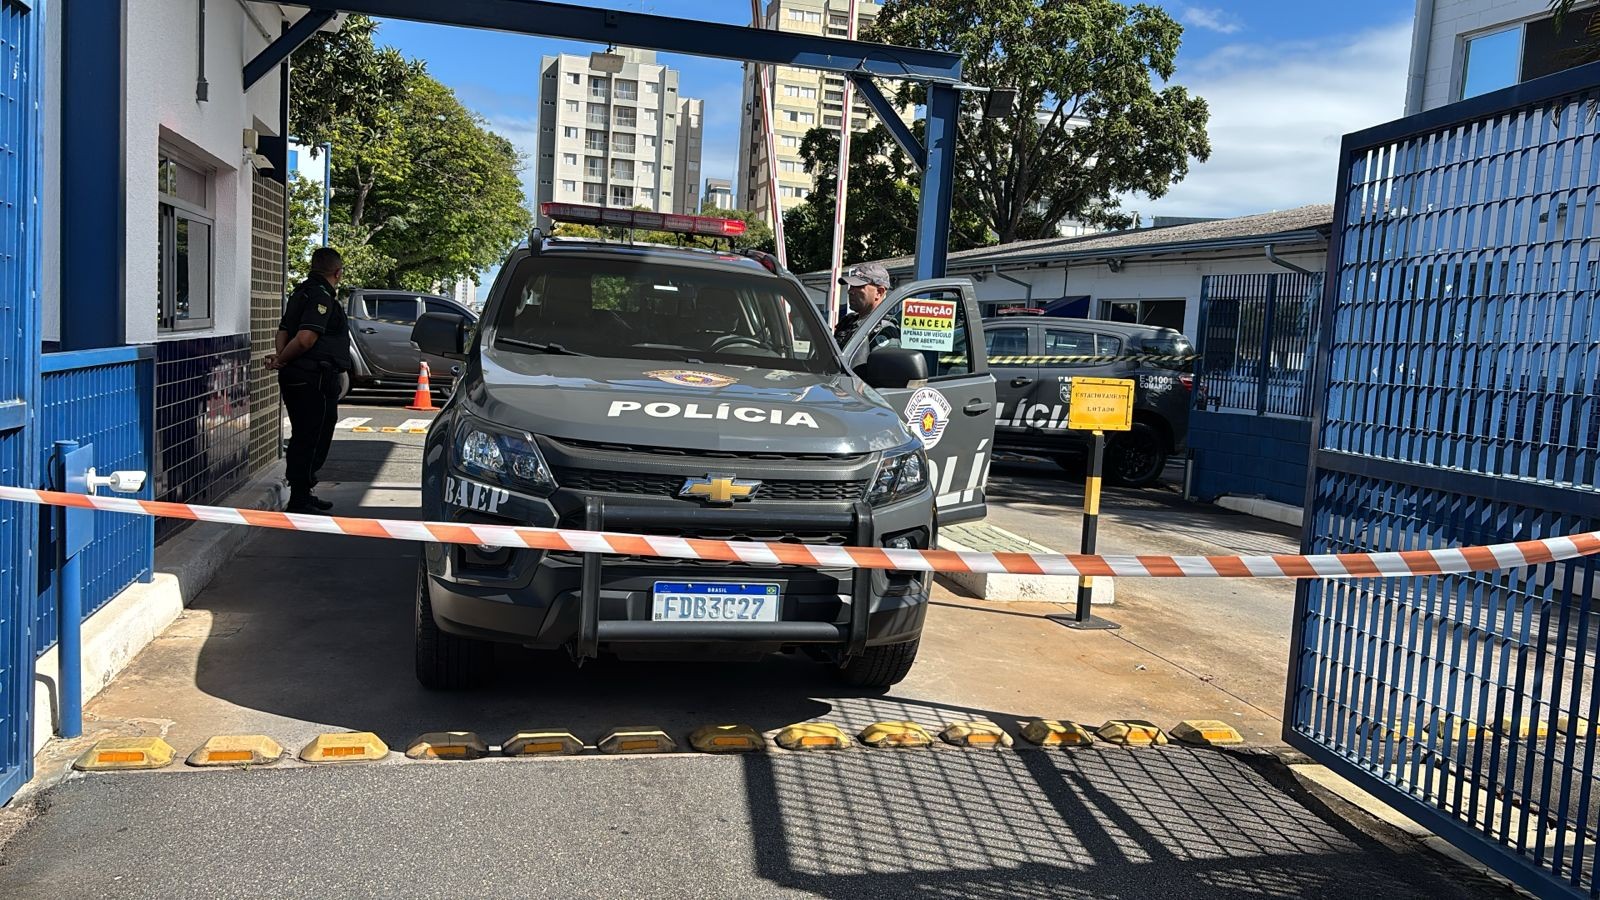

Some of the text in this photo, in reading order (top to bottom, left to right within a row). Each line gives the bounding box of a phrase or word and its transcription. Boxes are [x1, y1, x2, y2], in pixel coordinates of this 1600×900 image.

[906, 304, 953, 317] ATENÇÃO
[903, 317, 953, 329] CANCELA
[932, 330, 952, 338] VEÍCULO
[1139, 382, 1173, 391] COMANDO
[927, 391, 948, 412] MILITAR
[607, 401, 819, 429] POLÍCIA
[444, 476, 510, 514] BAEP
[654, 612, 663, 621] BR
